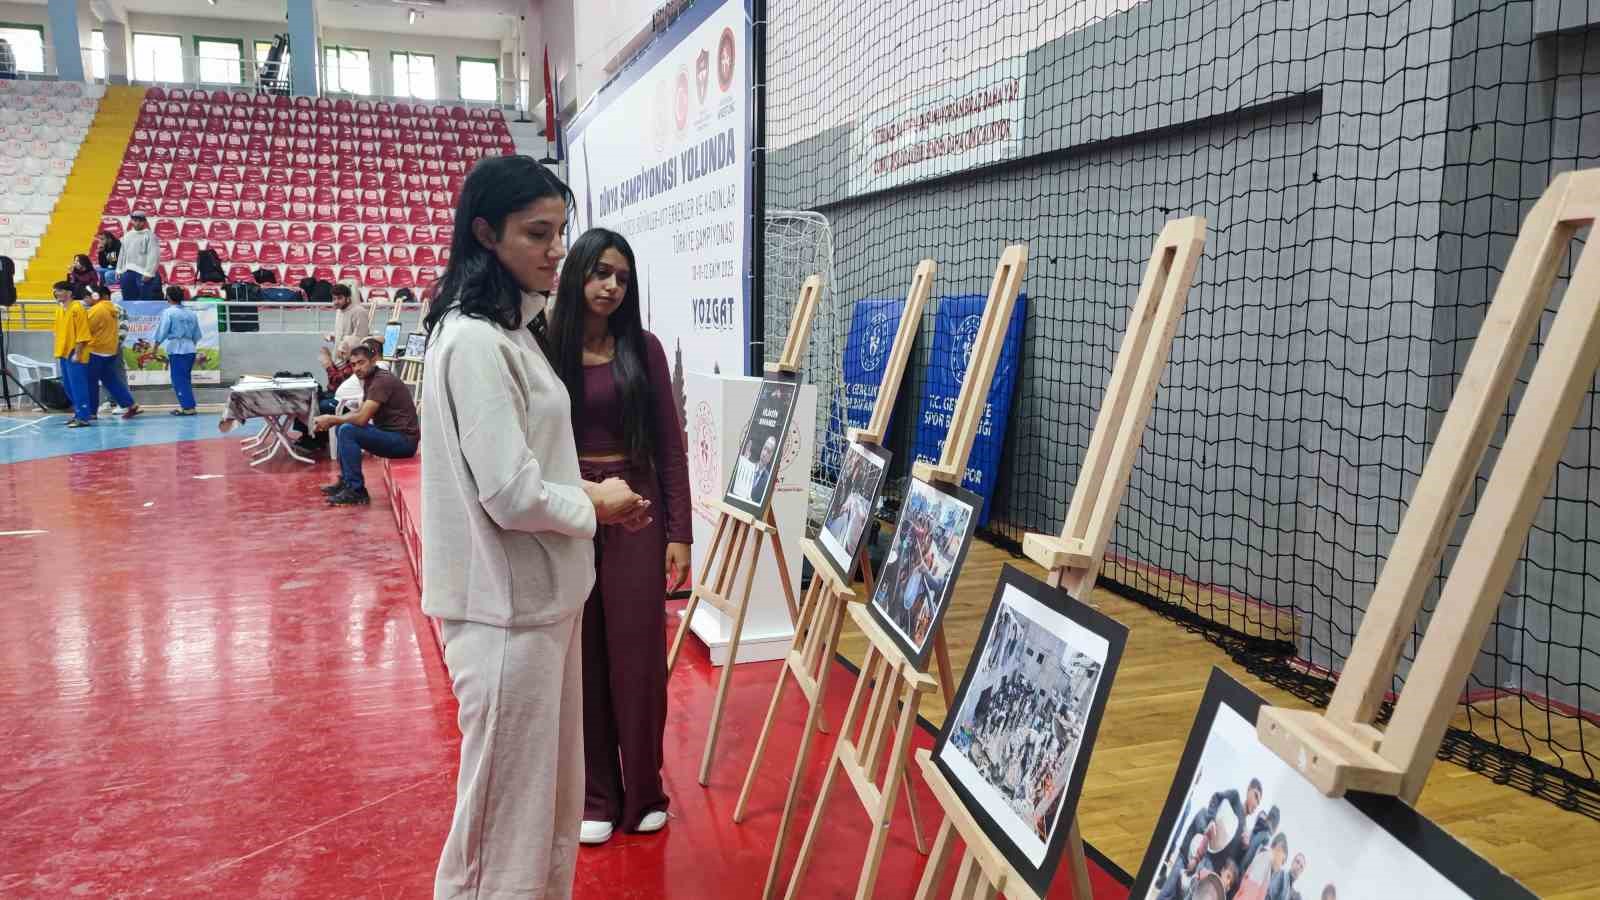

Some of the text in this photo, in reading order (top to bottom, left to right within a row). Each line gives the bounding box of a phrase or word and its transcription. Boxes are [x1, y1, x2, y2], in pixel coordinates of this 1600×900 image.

[599, 128, 735, 218] DÜNYA ŞAMPİYONASI YOLUNDA
[692, 296, 735, 326] YOZGAT
[924, 410, 944, 428] SPOR
